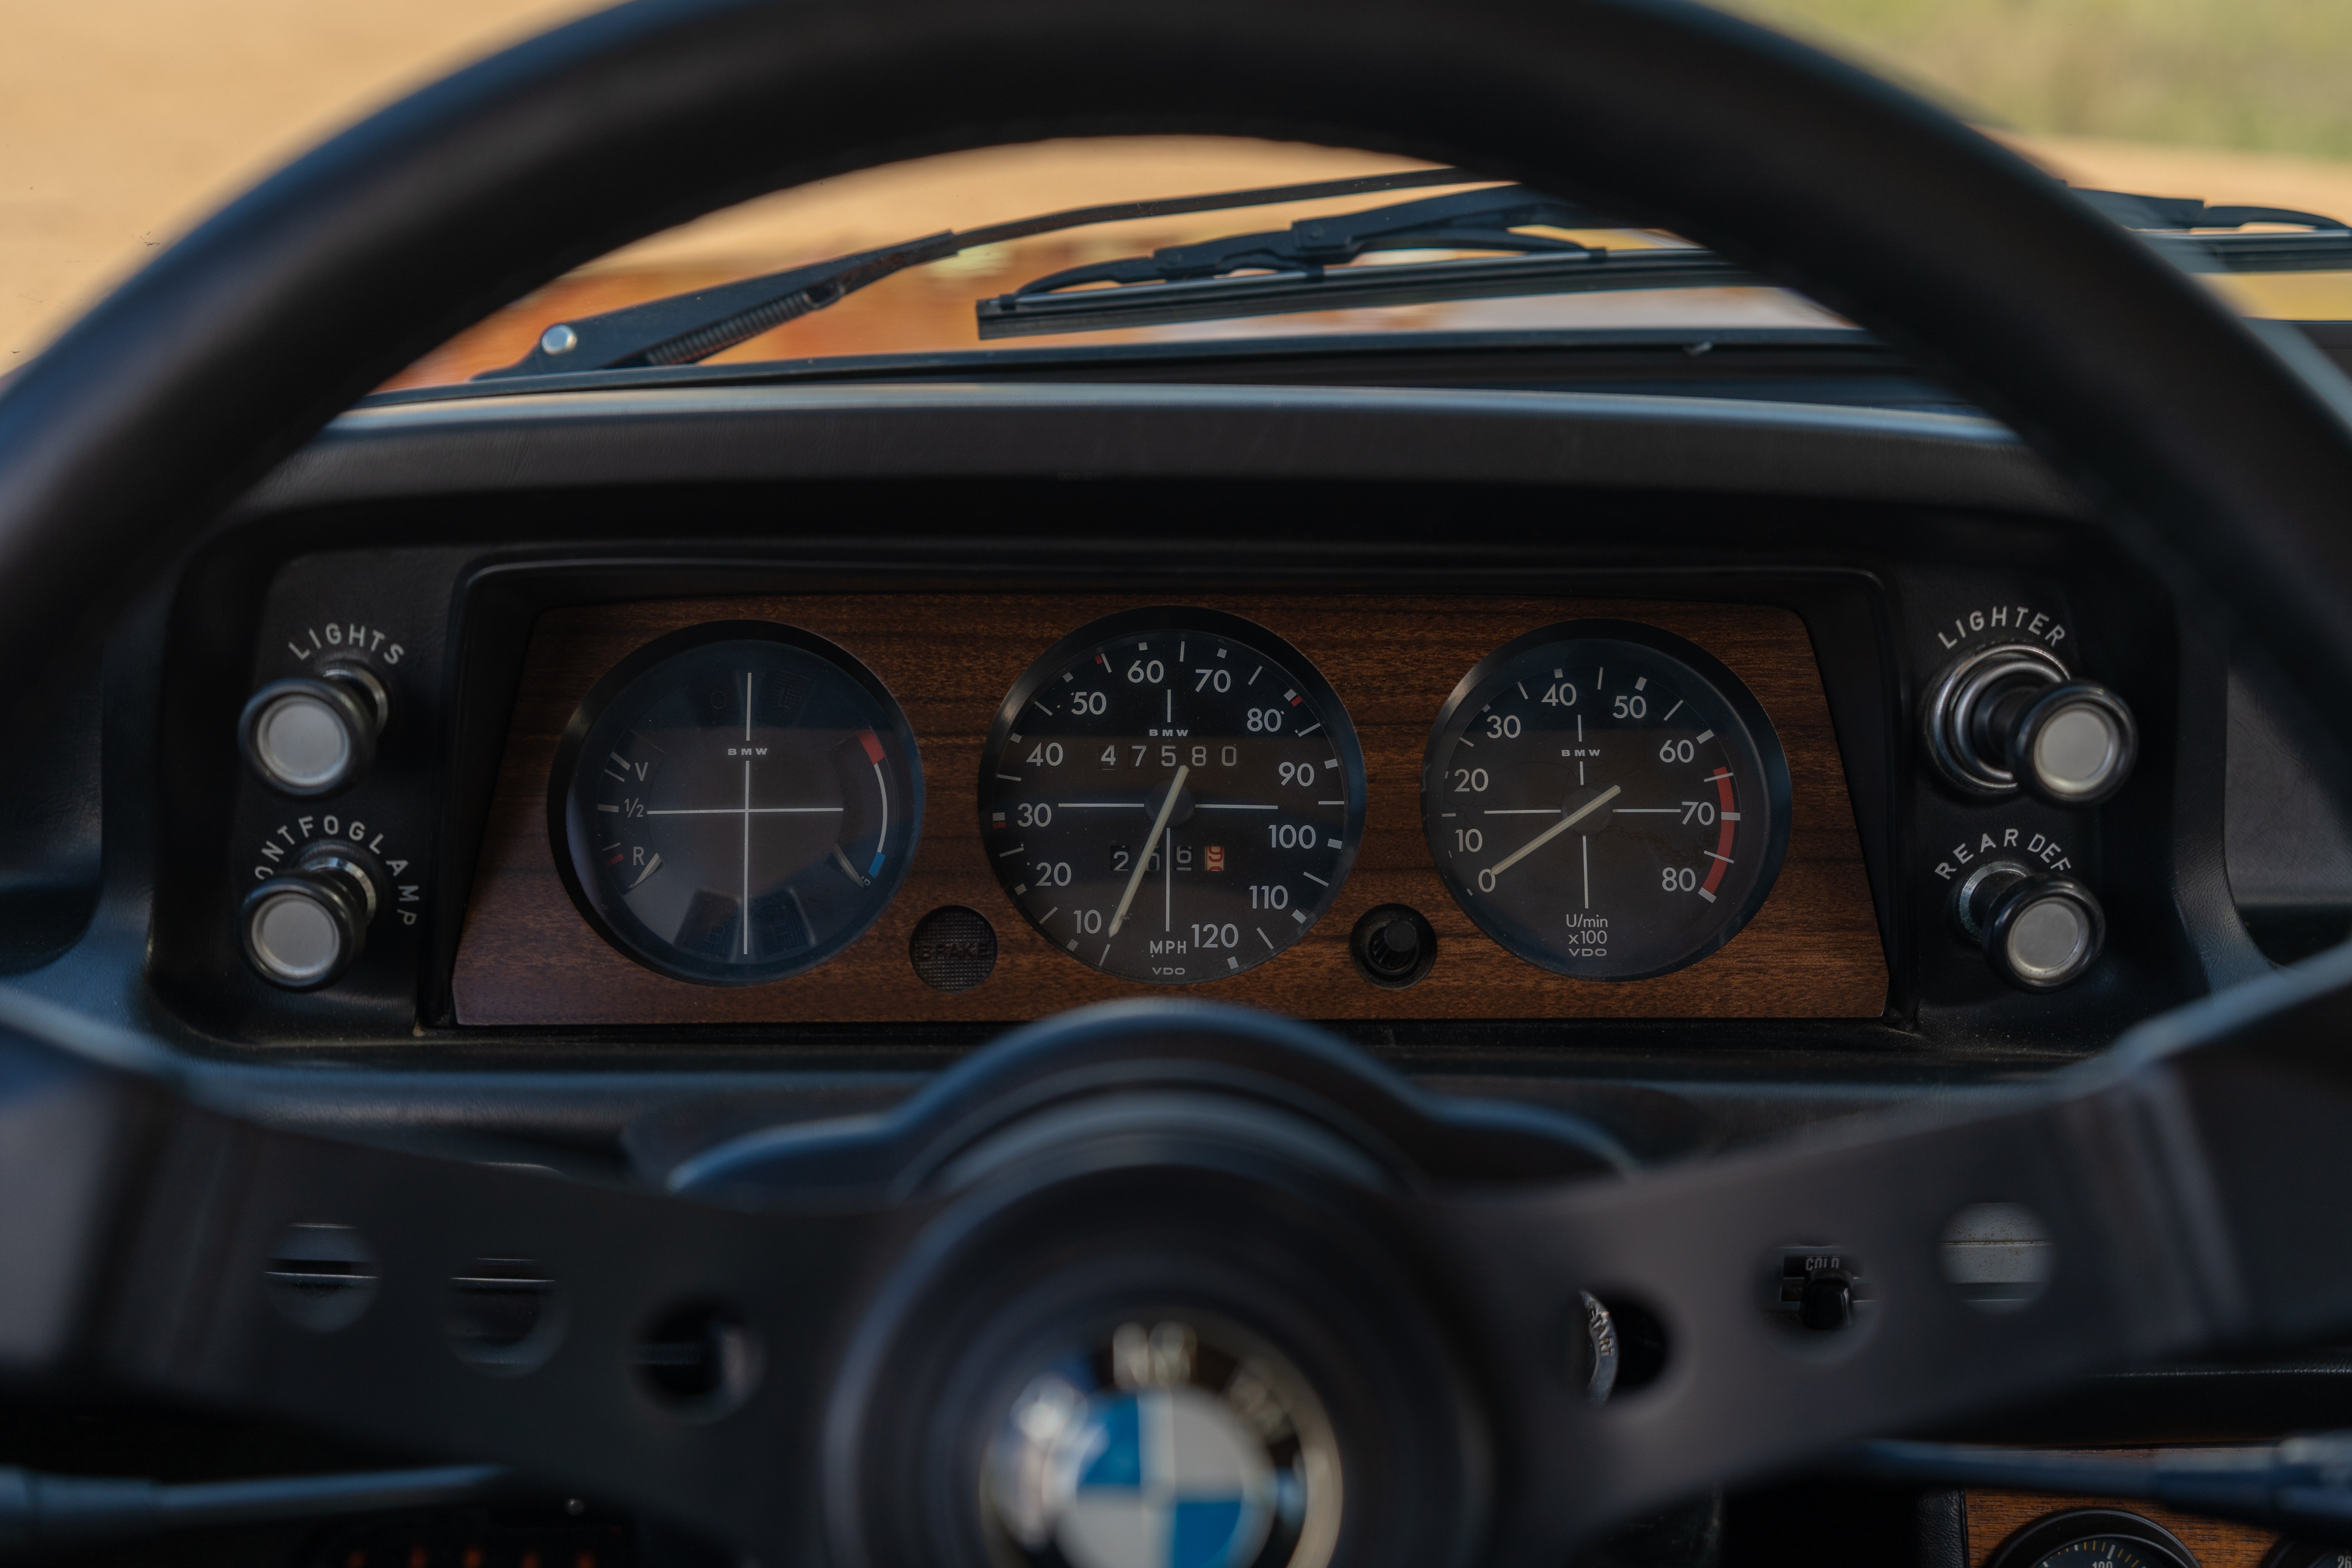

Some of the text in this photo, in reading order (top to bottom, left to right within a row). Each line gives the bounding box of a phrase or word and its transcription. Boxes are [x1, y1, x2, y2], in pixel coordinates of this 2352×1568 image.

[1938, 606, 2066, 649] LIGHTER
[288, 622, 404, 665] LIGHTS
[1128, 660, 1164, 683] 60
[1195, 669, 1231, 693] 70
[1071, 693, 1106, 715] 50
[1541, 683, 1577, 706] 40
[1613, 695, 1646, 719] 50
[1247, 708, 1281, 732] 80
[1487, 715, 1521, 738] 30
[1026, 742, 1063, 766] 40
[1101, 746, 1237, 767] 47580
[1660, 740, 1694, 763] 60
[635, 762, 648, 781] V
[1279, 761, 1314, 787] 90
[1455, 768, 1489, 792] 20
[1018, 803, 1051, 827] 30
[1682, 801, 1714, 826] 70
[1268, 824, 1316, 849] 100
[1456, 828, 1483, 852] 10
[633, 846, 644, 865] R
[1036, 862, 1071, 886] 20
[1478, 868, 1496, 893] 0
[1662, 867, 1696, 891] 80
[1249, 885, 1288, 909] 110
[1073, 909, 1102, 934] 10
[1566, 914, 1608, 928] U/min
[1150, 940, 1186, 954] MPH
[1191, 923, 1238, 948] 120
[1569, 930, 1607, 944] x100
[1568, 948, 1607, 957] VDO
